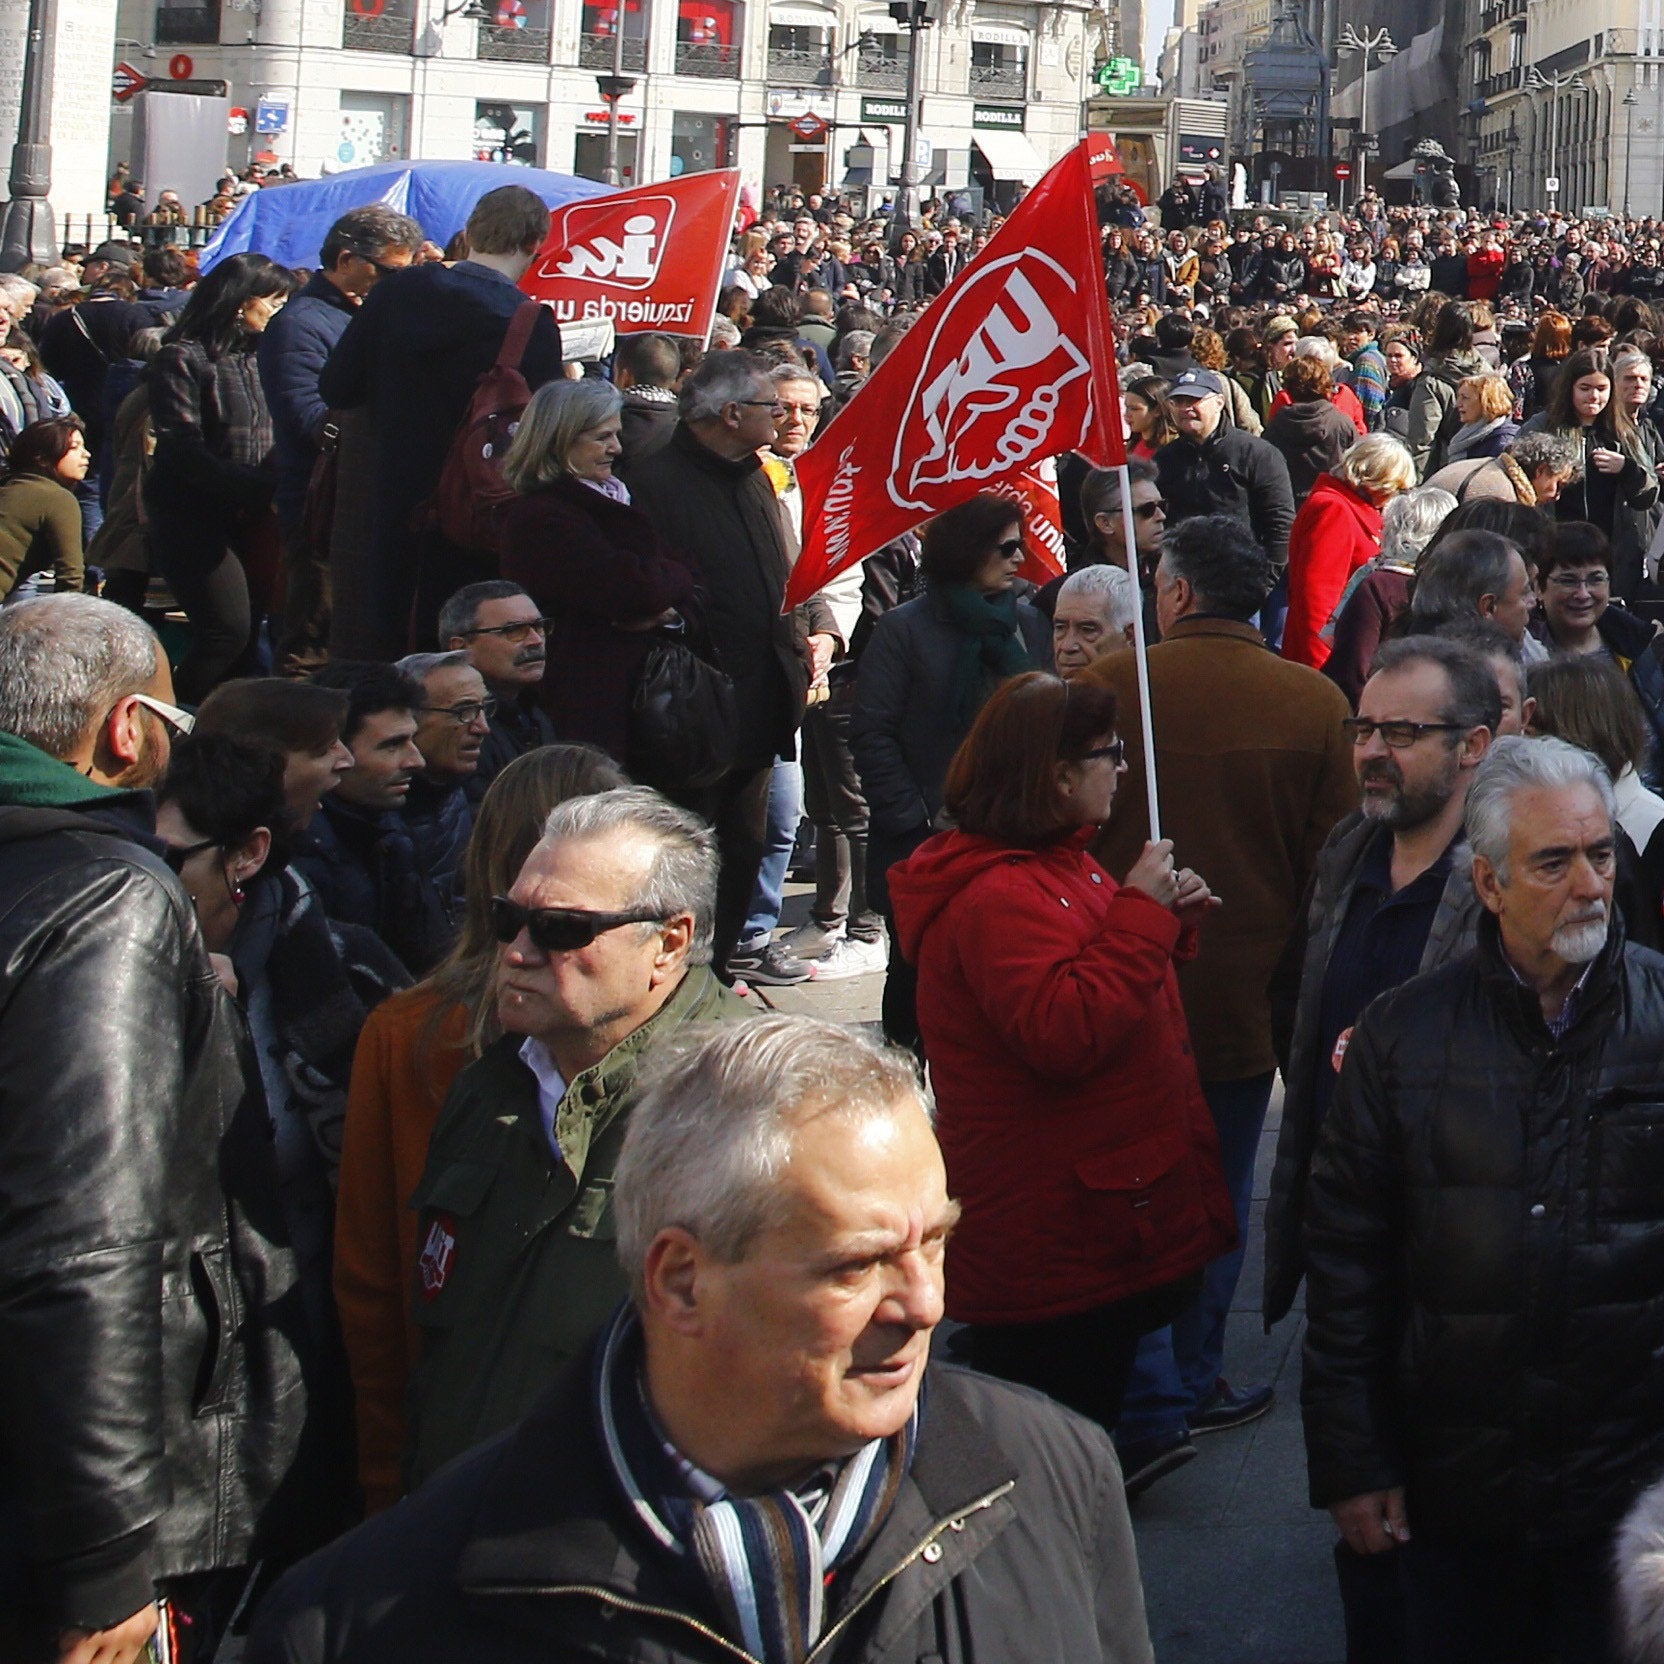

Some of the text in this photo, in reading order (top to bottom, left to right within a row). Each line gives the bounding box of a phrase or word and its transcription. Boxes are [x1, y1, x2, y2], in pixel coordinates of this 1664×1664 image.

[977, 30, 1026, 43] RODILLA
[865, 102, 907, 116] RODIL
[974, 108, 1022, 124] RODILLA
